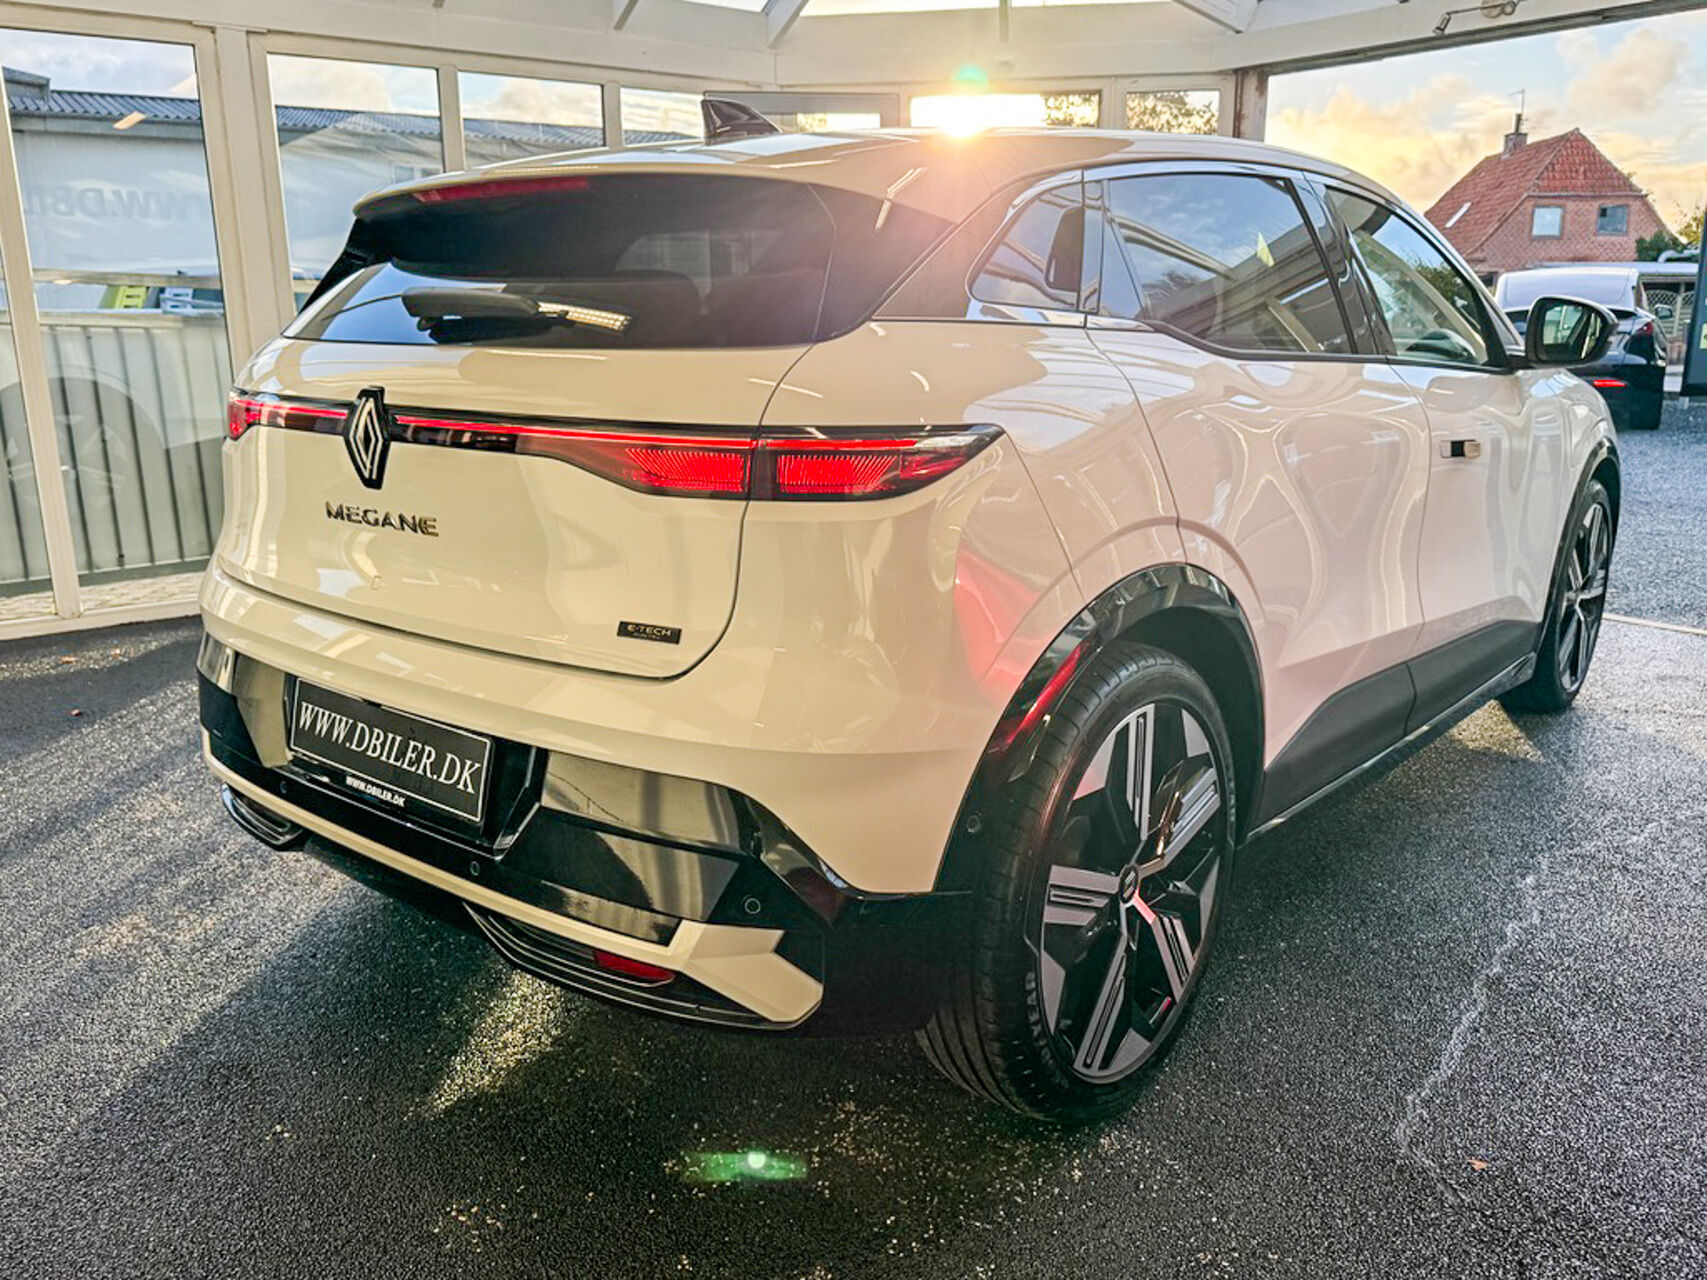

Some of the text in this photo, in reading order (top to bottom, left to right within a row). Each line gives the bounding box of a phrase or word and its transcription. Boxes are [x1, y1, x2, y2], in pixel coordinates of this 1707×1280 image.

[325, 501, 439, 537] MEGANE
[627, 624, 671, 637] E-TECH
[300, 701, 481, 794] WWW.DBILER.DK
[346, 775, 407, 807] WWW.DBILER.DK
